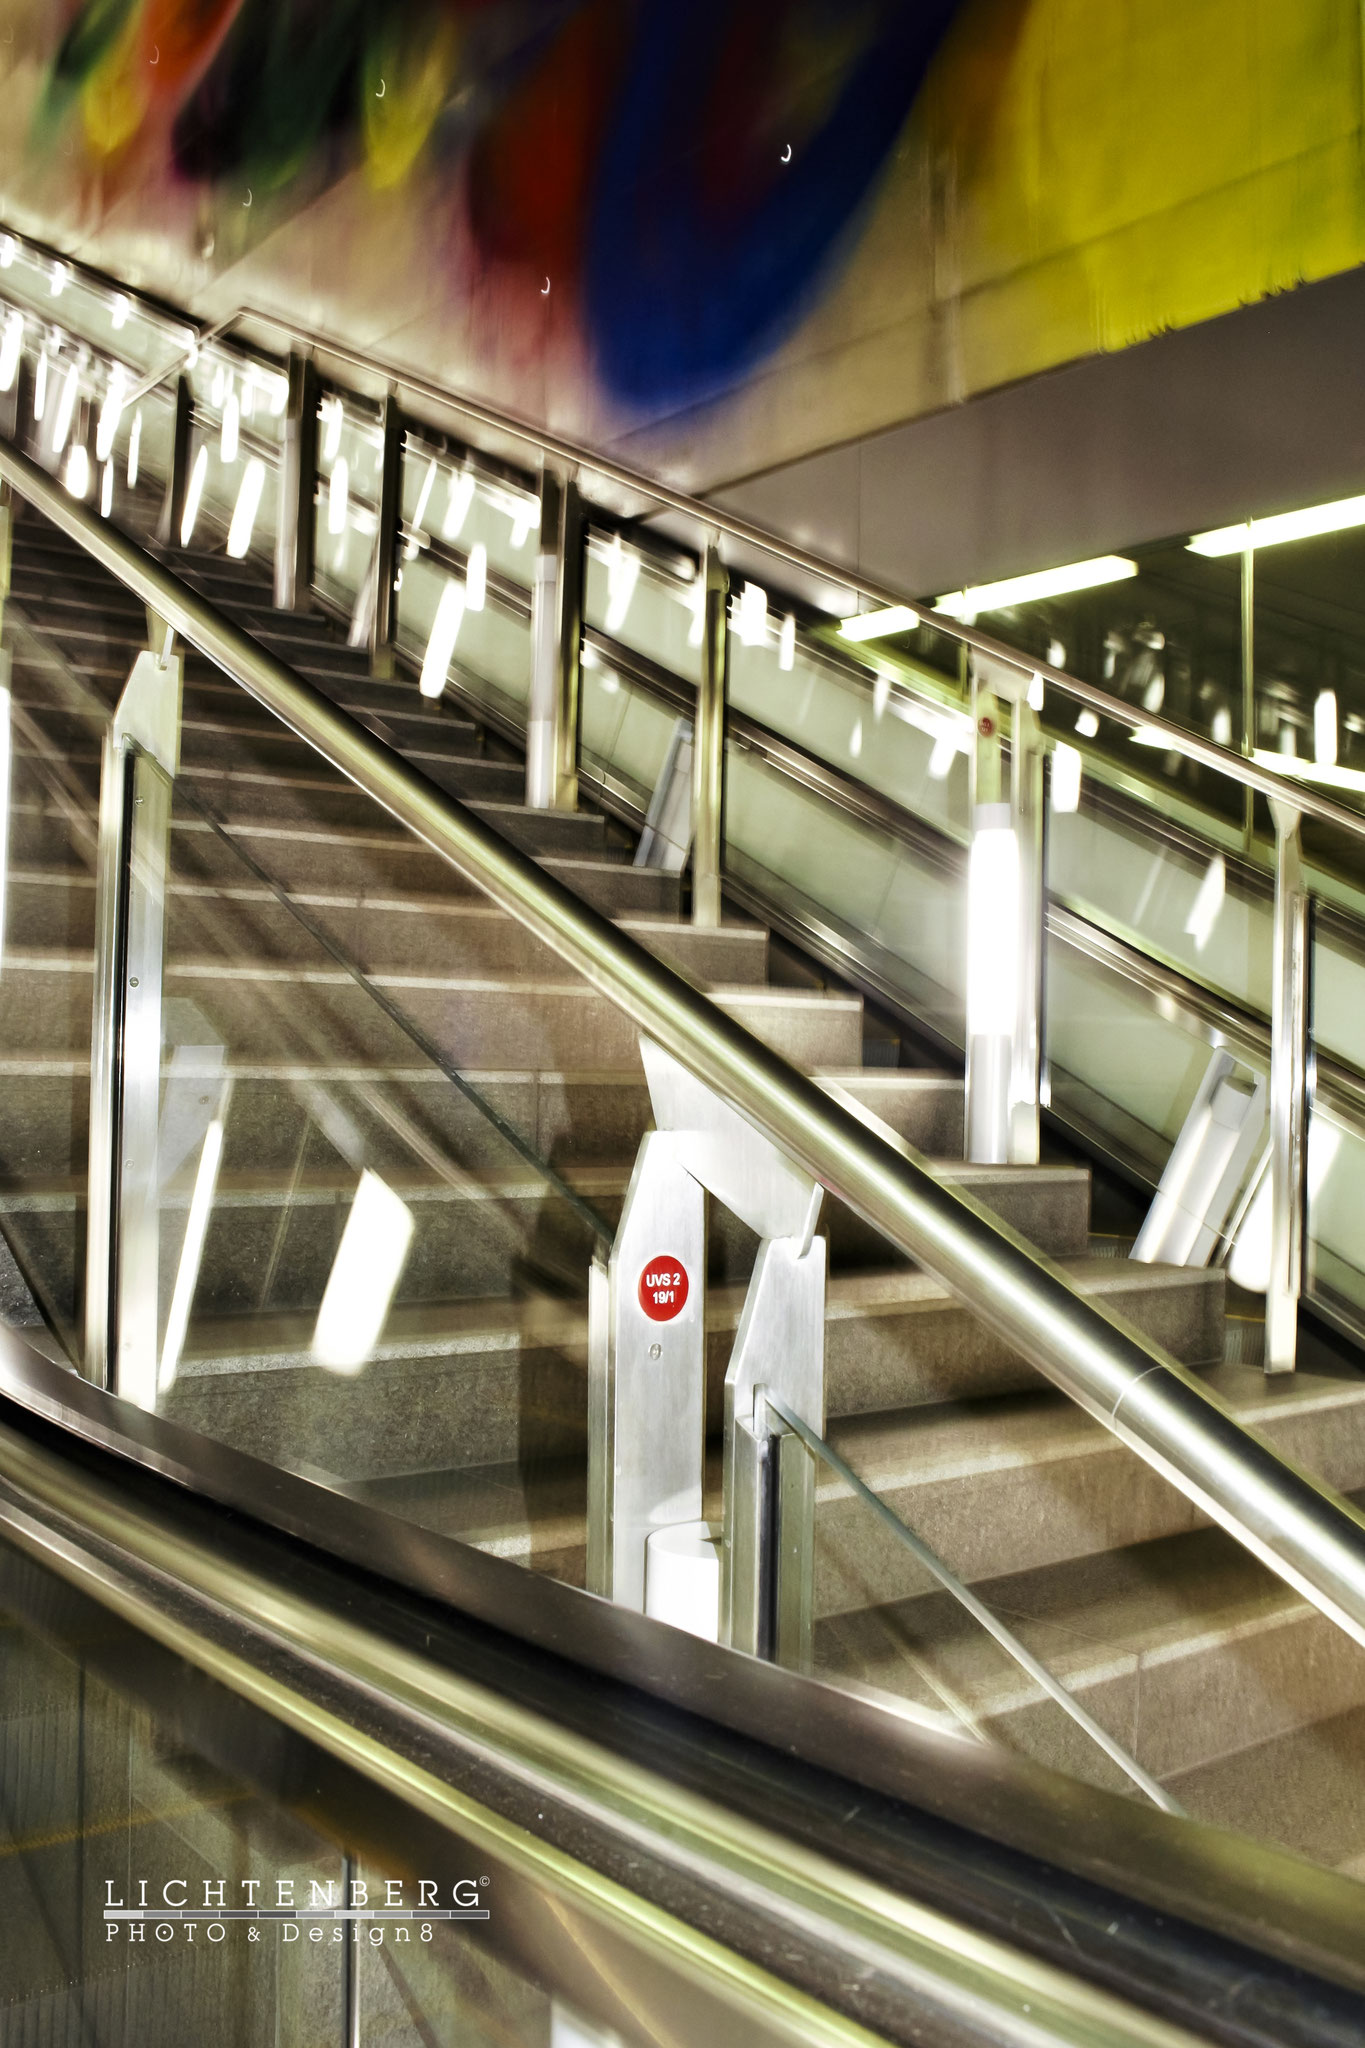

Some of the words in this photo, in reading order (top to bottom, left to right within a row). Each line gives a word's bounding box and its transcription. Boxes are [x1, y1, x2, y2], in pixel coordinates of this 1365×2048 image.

[646, 1273, 671, 1288] UVS
[672, 1272, 681, 1286] 2
[652, 1290, 675, 1304] 19/1
